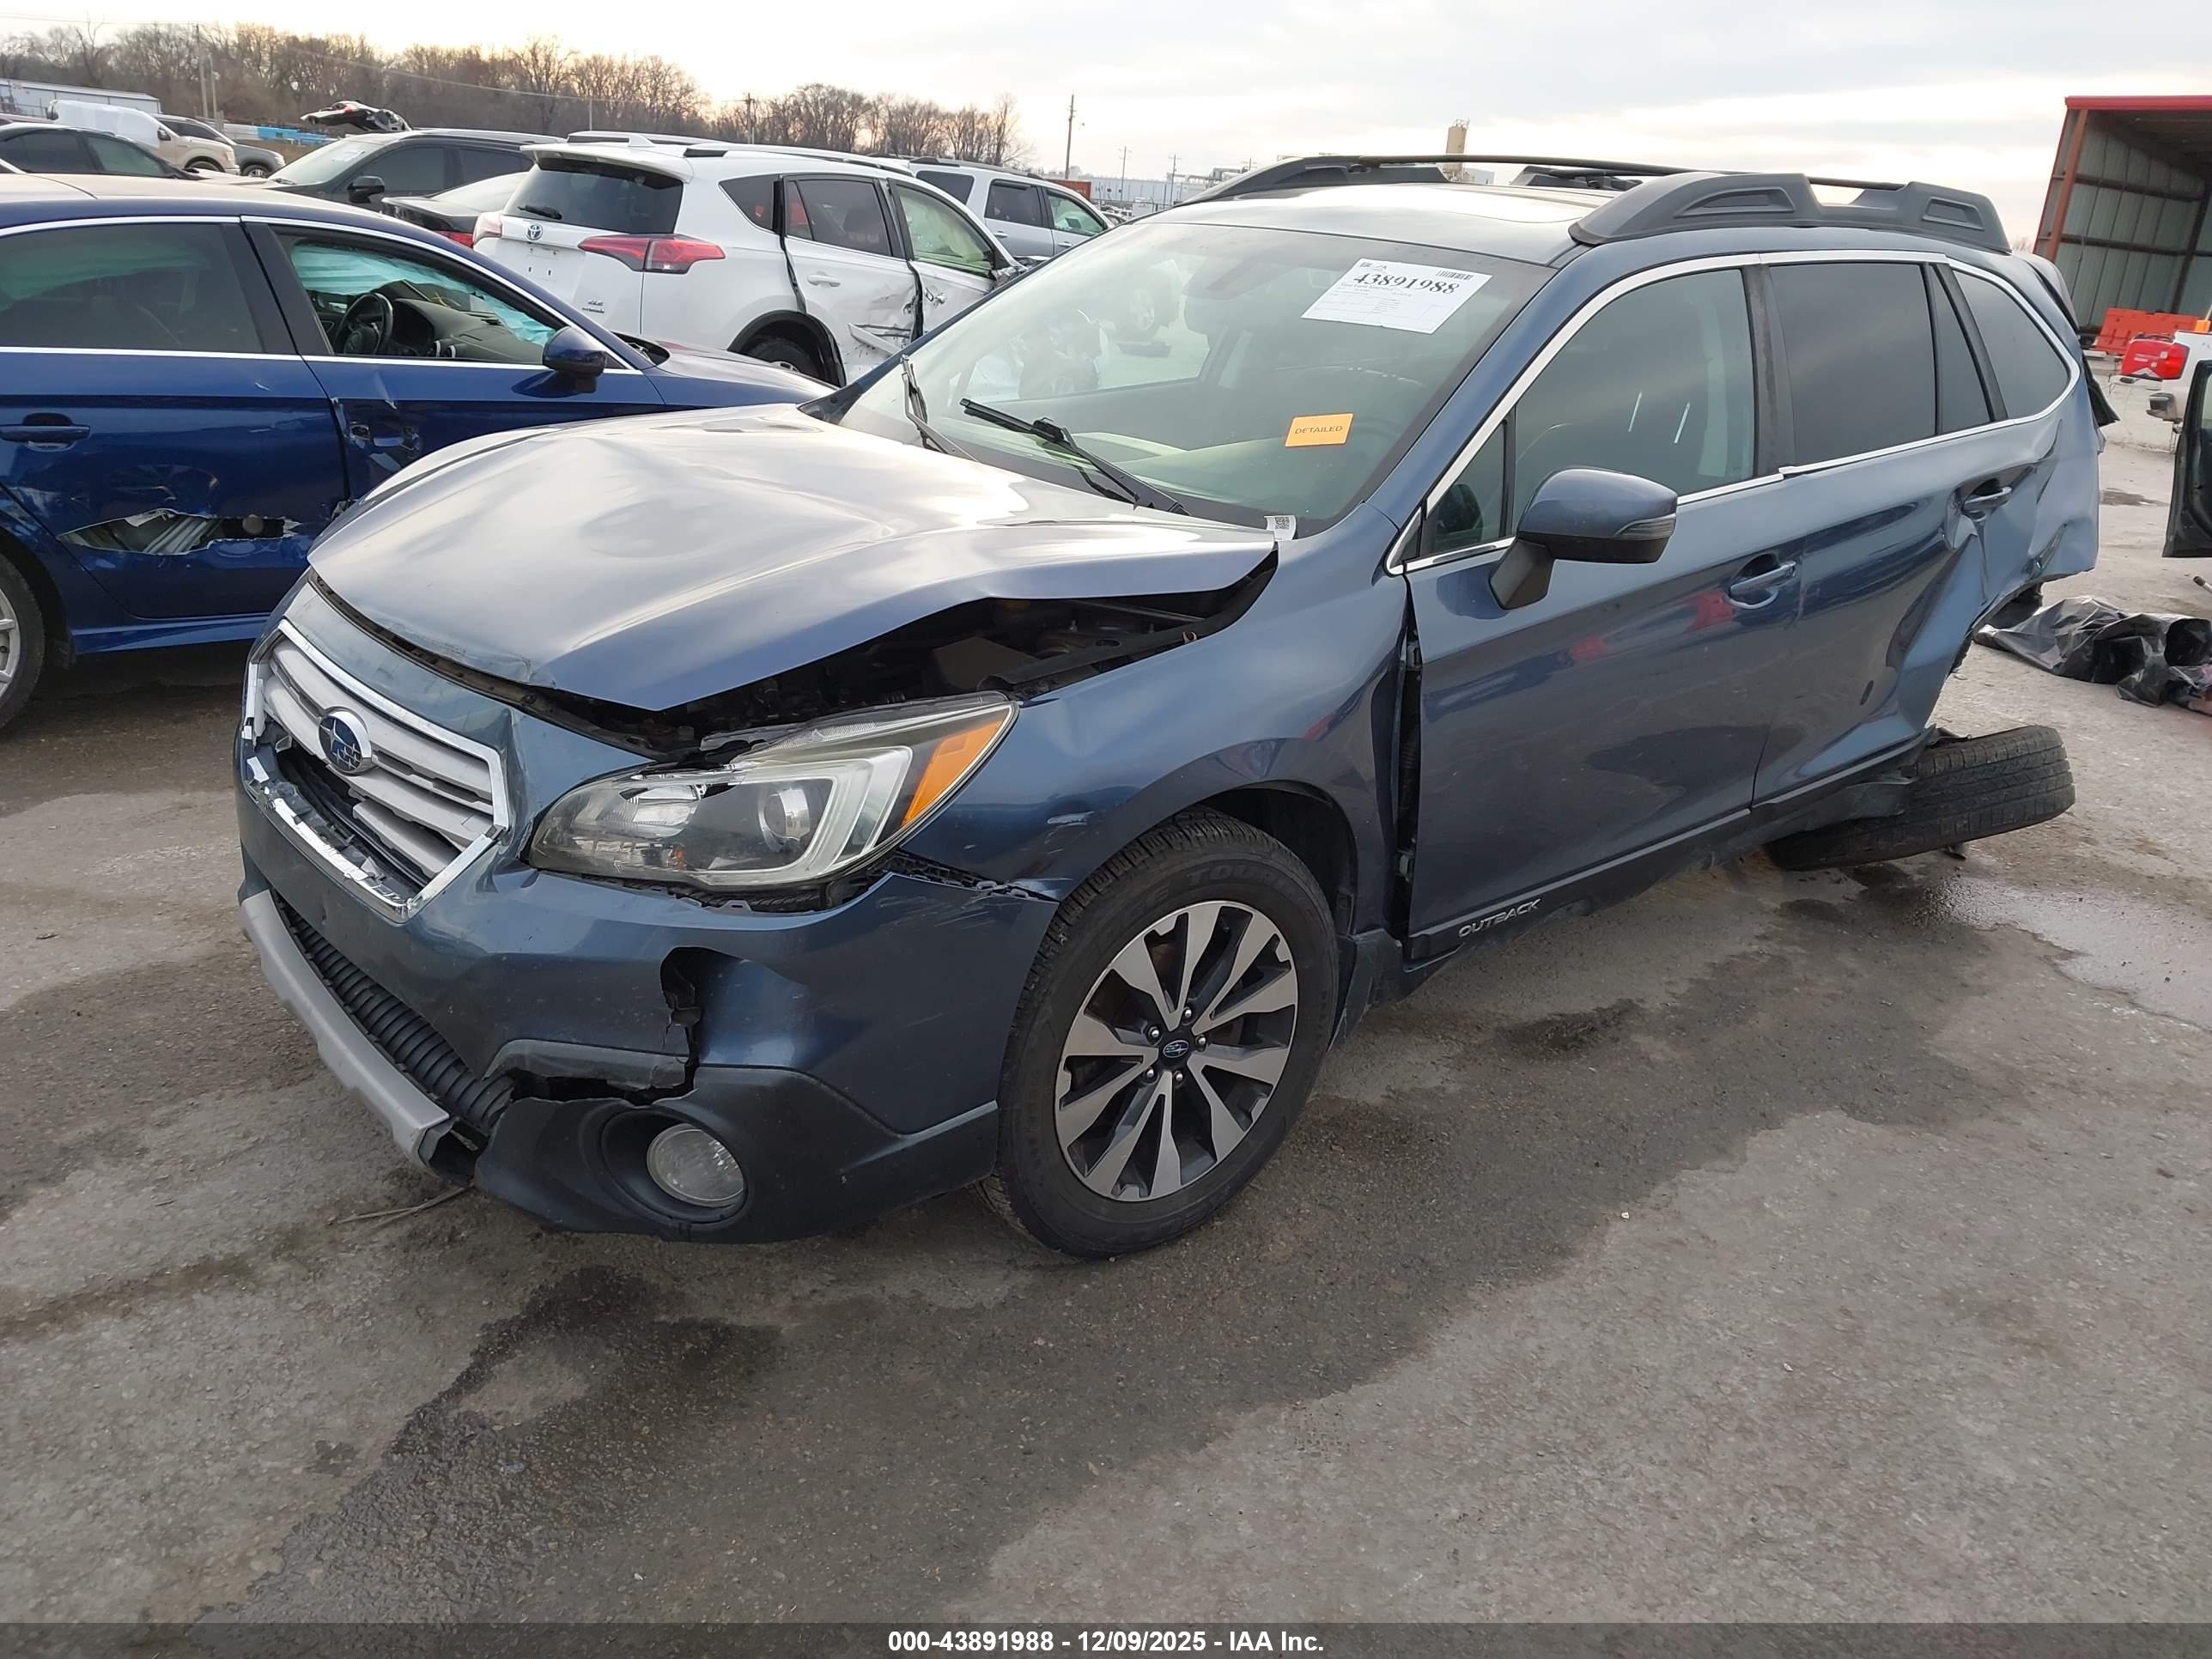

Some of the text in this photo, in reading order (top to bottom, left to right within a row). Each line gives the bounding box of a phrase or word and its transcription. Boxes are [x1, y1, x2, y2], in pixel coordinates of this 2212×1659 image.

[1354, 273, 1460, 294] 43891988
[1294, 425, 1343, 434] DETAILED
[1458, 898, 1541, 938] OUTBACK
